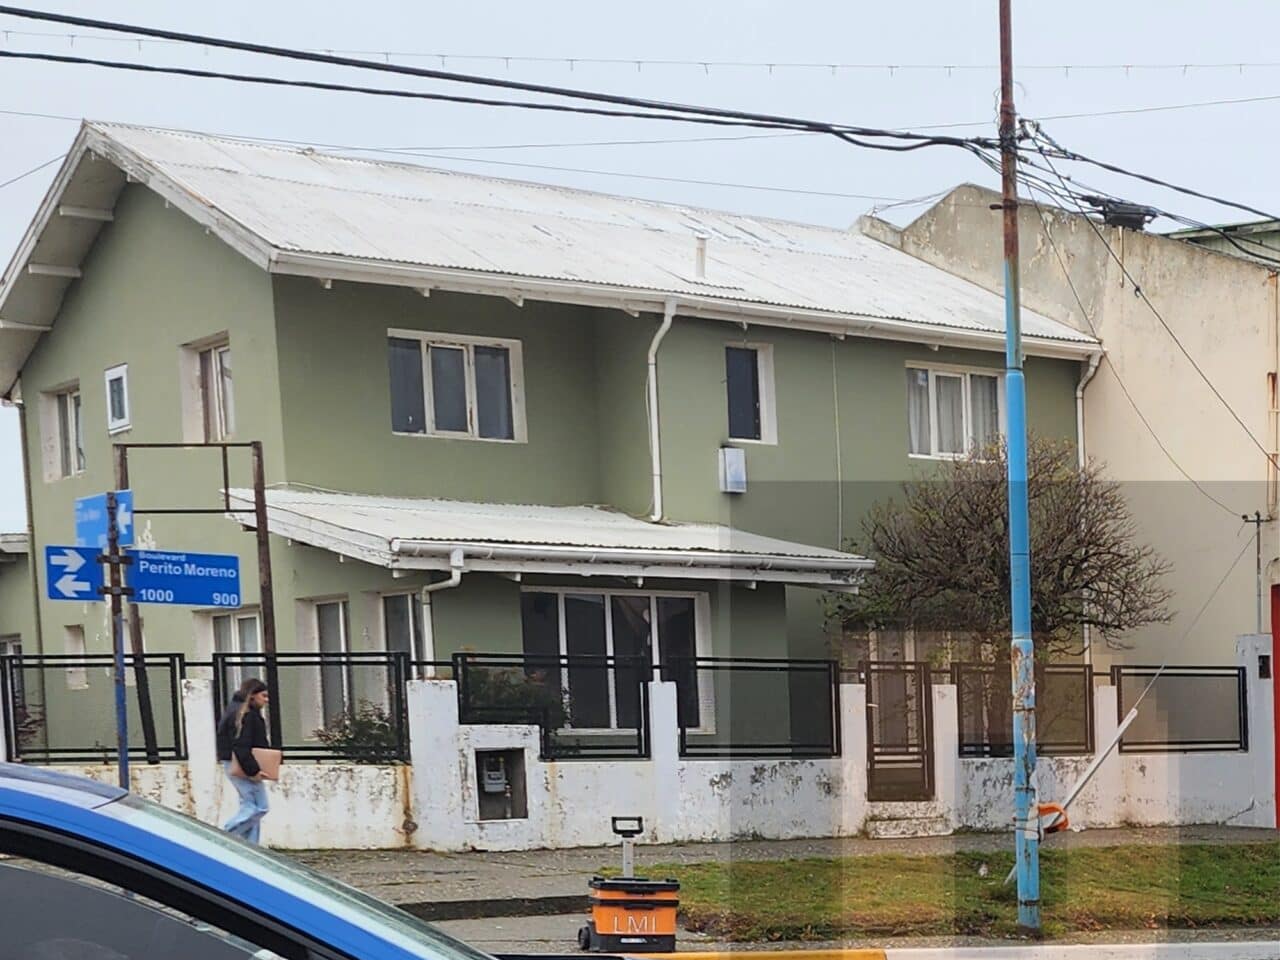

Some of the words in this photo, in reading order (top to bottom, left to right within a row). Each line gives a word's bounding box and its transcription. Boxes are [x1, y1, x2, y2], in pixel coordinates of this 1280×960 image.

[139, 560, 182, 575] Perito
[184, 563, 237, 578] Moreno
[140, 588, 174, 602] 1000
[212, 592, 238, 606] 900
